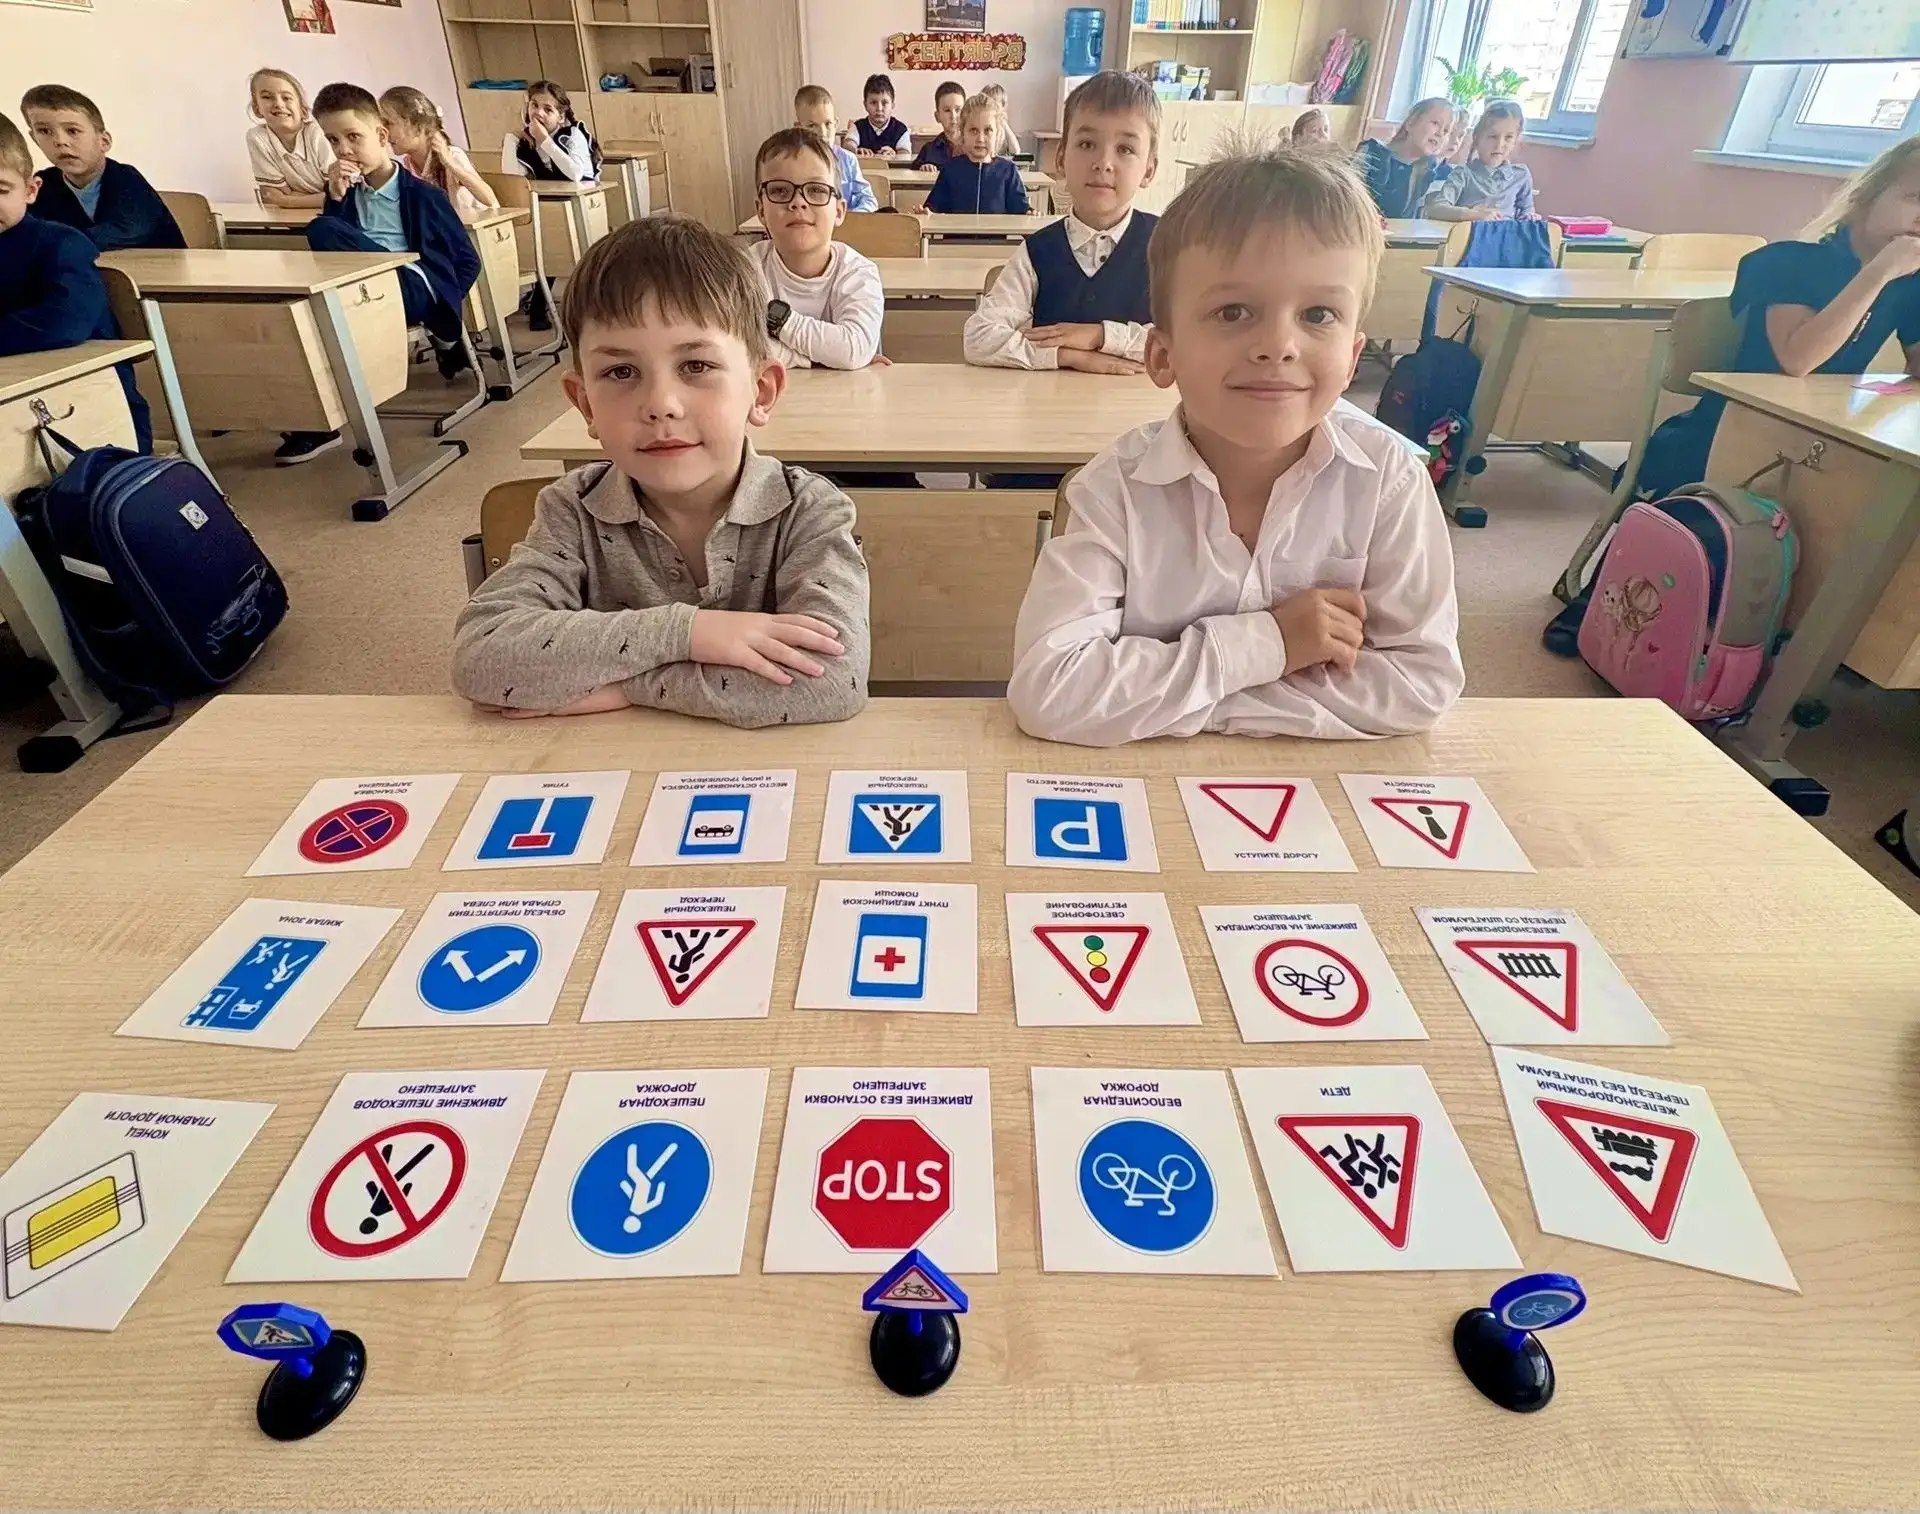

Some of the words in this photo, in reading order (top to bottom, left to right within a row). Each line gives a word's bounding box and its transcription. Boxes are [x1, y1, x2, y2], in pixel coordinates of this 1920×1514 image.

[889, 33, 909, 70] 1
[907, 41, 1022, 62] СЕНТЯБРЯ
[1060, 780, 1124, 789] (ПАРКОВОЧНОЕ
[874, 890, 919, 898] ПОМОЩИ
[463, 900, 496, 908] СЛЕВА
[680, 896, 725, 904] ПЕРЕХОД
[842, 898, 916, 907] МЕДИЦИНСКОЙ
[918, 900, 949, 908] ПУНКТ
[664, 905, 736, 913] ПЕШЕХОДНЫЙ
[1045, 902, 1128, 910] РЕГУЛИРОВАНИЕ
[448, 909, 521, 918] ПРЕПЯТСТВИЯ
[522, 909, 565, 917] ОБЪЕЗД
[1051, 911, 1125, 919] СВЕТОФОРНОЕ
[1254, 913, 1313, 922] ЗАПРЕЩЕНО
[278, 915, 304, 924] ЗОНА
[307, 917, 344, 927] ЖИЛАЯ
[1432, 916, 1504, 924] ШЛАГБАУМОМ
[1521, 916, 1567, 924] ПЕРЕЕЗД
[1215, 923, 1288, 932] ВЕЛОСИПЕДАХ
[1290, 922, 1304, 930] НА
[1306, 922, 1358, 930] ДВИЖЕНИЕ
[1452, 926, 1560, 934] ЖЕЛЕЗНОДОРОЖНЫЙ
[1516, 1063, 1598, 1087] ШЛАГБАУМА
[398, 1084, 476, 1095] ЗАПРЕЩЕНО
[636, 1082, 697, 1094] ДОРОЖКА
[853, 1081, 927, 1092] ЗАПРЕЩЕНО
[1101, 1082, 1159, 1093] ДОРОЖКА
[1601, 1080, 1627, 1093] БЕЗ
[1320, 1087, 1351, 1097] ДЕТИ
[1629, 1084, 1690, 1106] ПЕРЕЕЗД
[434, 1097, 508, 1109] ДВИЖЕНИЕ
[619, 1097, 706, 1109] ПЕШЕХОДНАЯ
[804, 1094, 877, 1105] ОСТАНОВКИ
[880, 1094, 902, 1105] БЕЗ
[903, 1094, 973, 1105] ДВИЖЕНИЕ
[1083, 1096, 1182, 1107] ВЕЛОСИПЕДНАЯ
[1536, 1079, 1680, 1117] ЖЕЛЕЗНОДОРОЖНЫЙ
[353, 1099, 432, 1110] ПЕШЕХОДОВ
[103, 1110, 160, 1124] ДОРОГИ
[154, 1112, 217, 1127] ГЛАВНОЙ
[125, 1126, 169, 1140] КОНЕЦ
[822, 1160, 943, 1201] STOP
